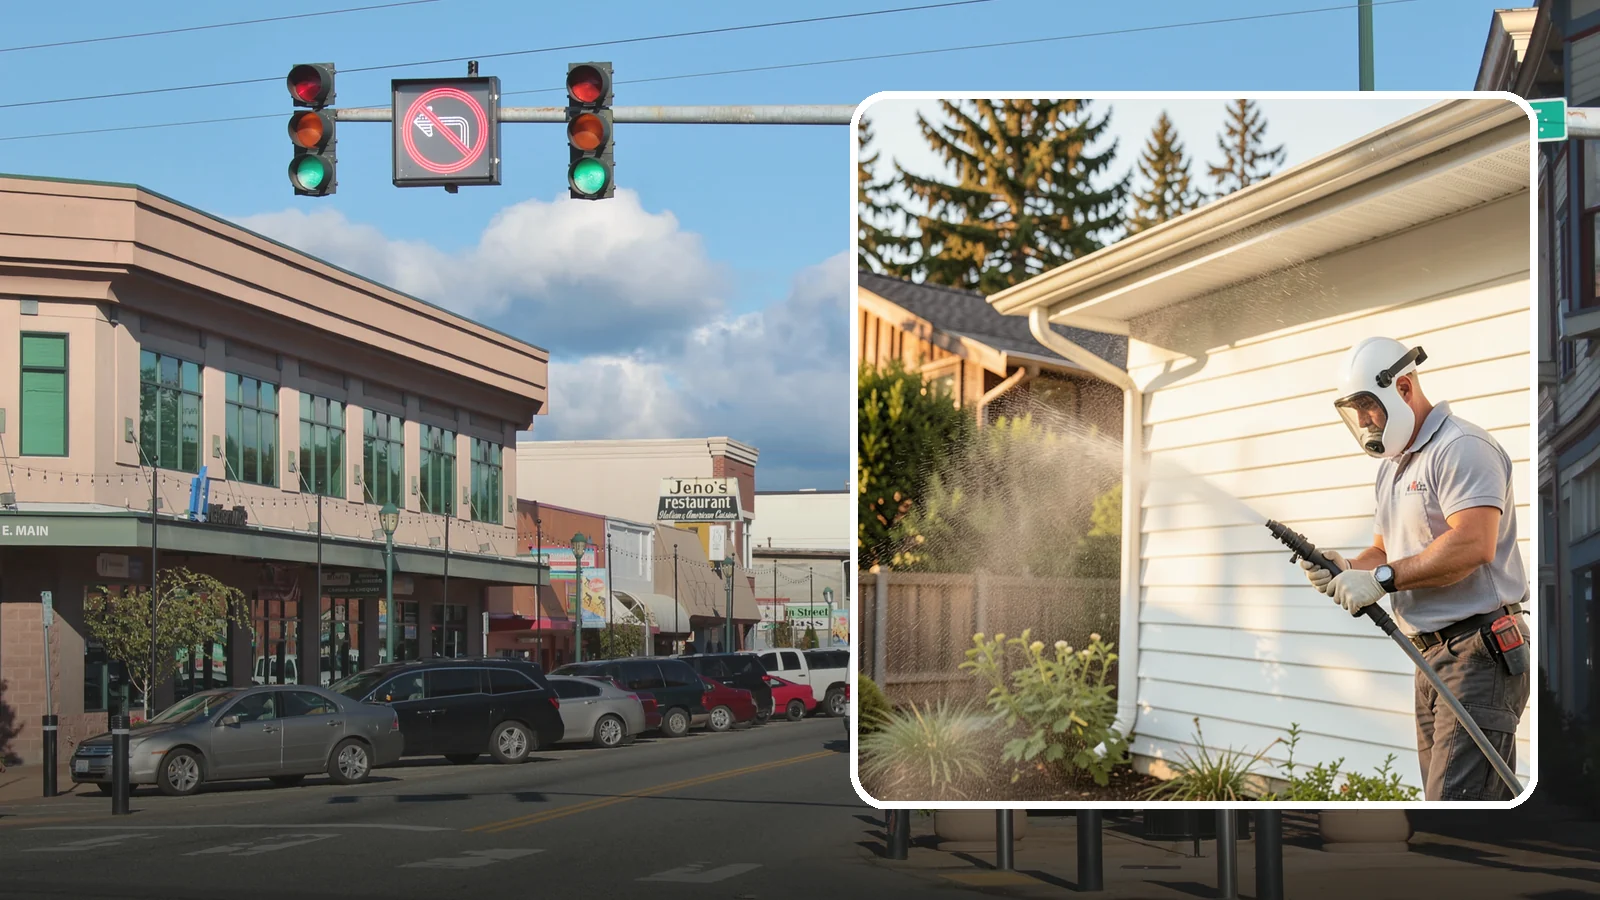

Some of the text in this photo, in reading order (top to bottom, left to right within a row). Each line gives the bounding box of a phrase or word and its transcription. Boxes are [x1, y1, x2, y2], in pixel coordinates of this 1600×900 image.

[669, 480, 727, 494] Jeno's
[665, 497, 731, 509] restaurant
[659, 510, 681, 519] Italian
[686, 509, 715, 519] American
[715, 509, 738, 519] Cuisine
[2, 525, 49, 536] E. MAIN
[797, 607, 829, 616] Street
